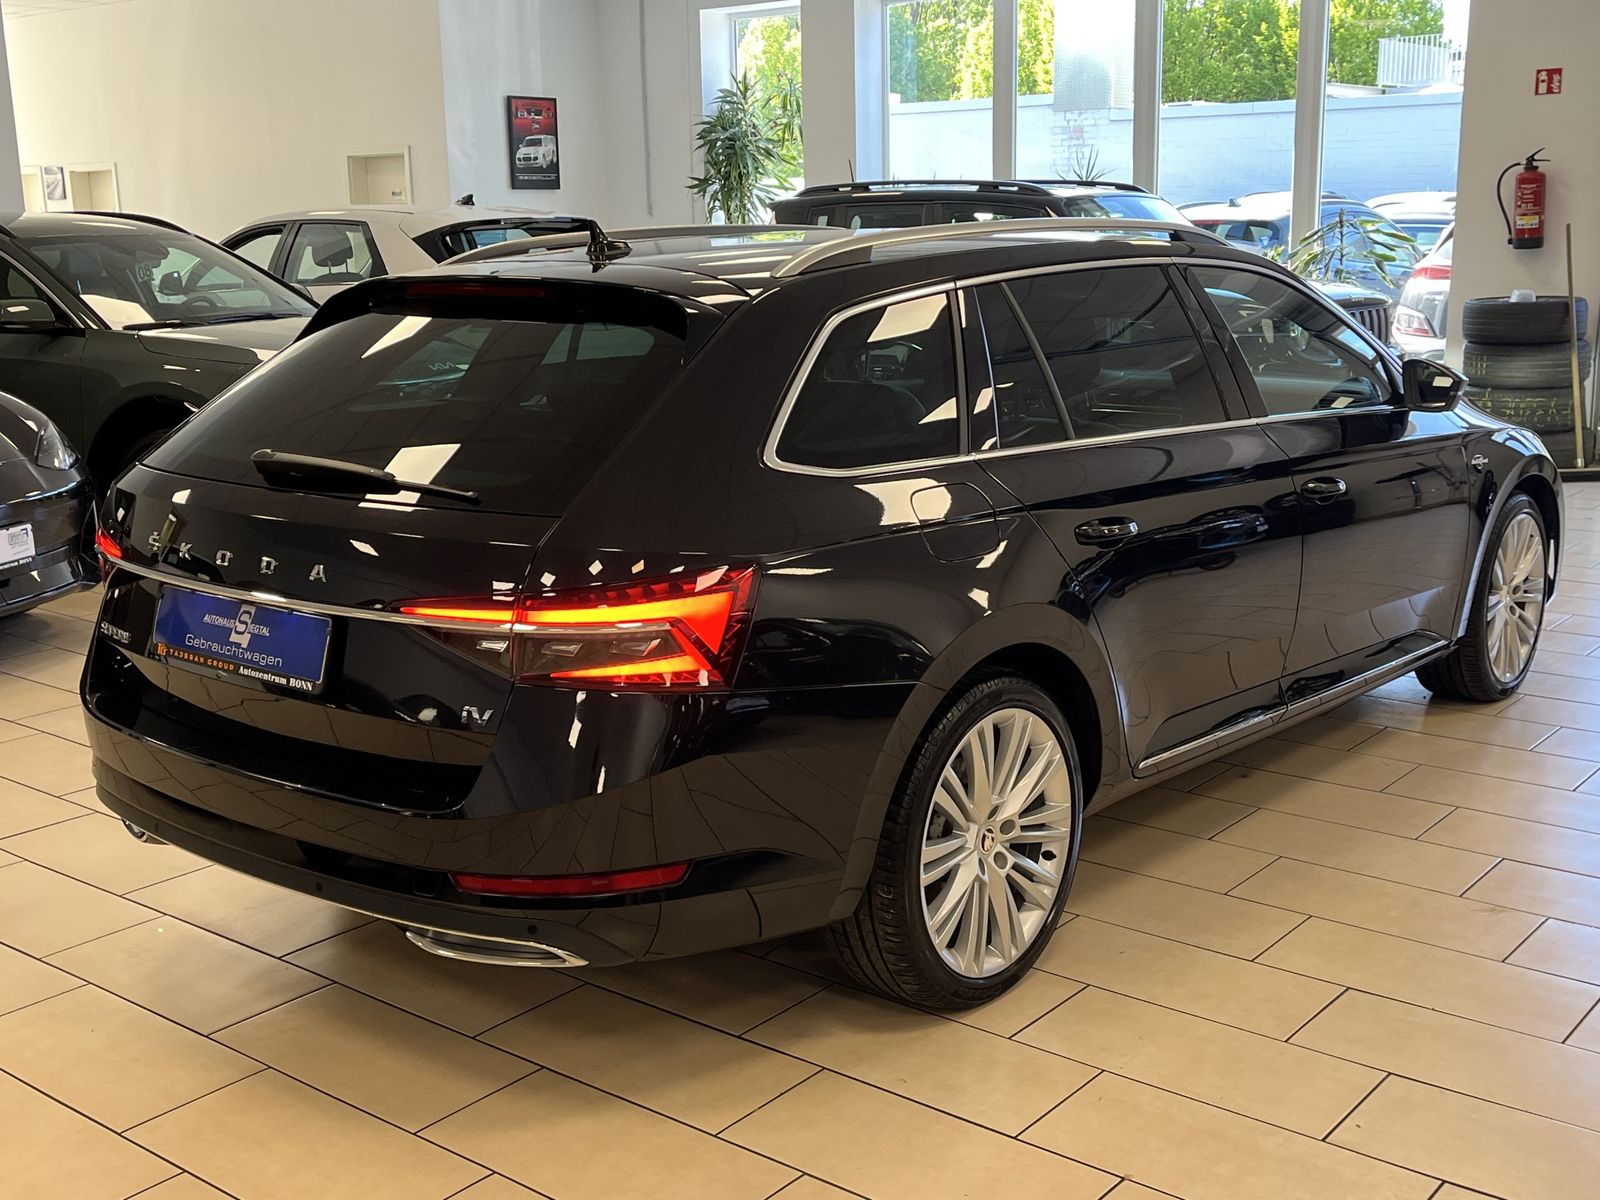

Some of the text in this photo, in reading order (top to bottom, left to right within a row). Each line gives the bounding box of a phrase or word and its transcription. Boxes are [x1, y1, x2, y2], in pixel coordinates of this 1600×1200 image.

[202, 609, 270, 637] AUTOHAUS SIEGTAL
[185, 633, 283, 667] Gebrauchtwagen
[207, 658, 235, 671] GROUP
[238, 665, 287, 685] Autozentrum
[289, 679, 314, 691] BONN
